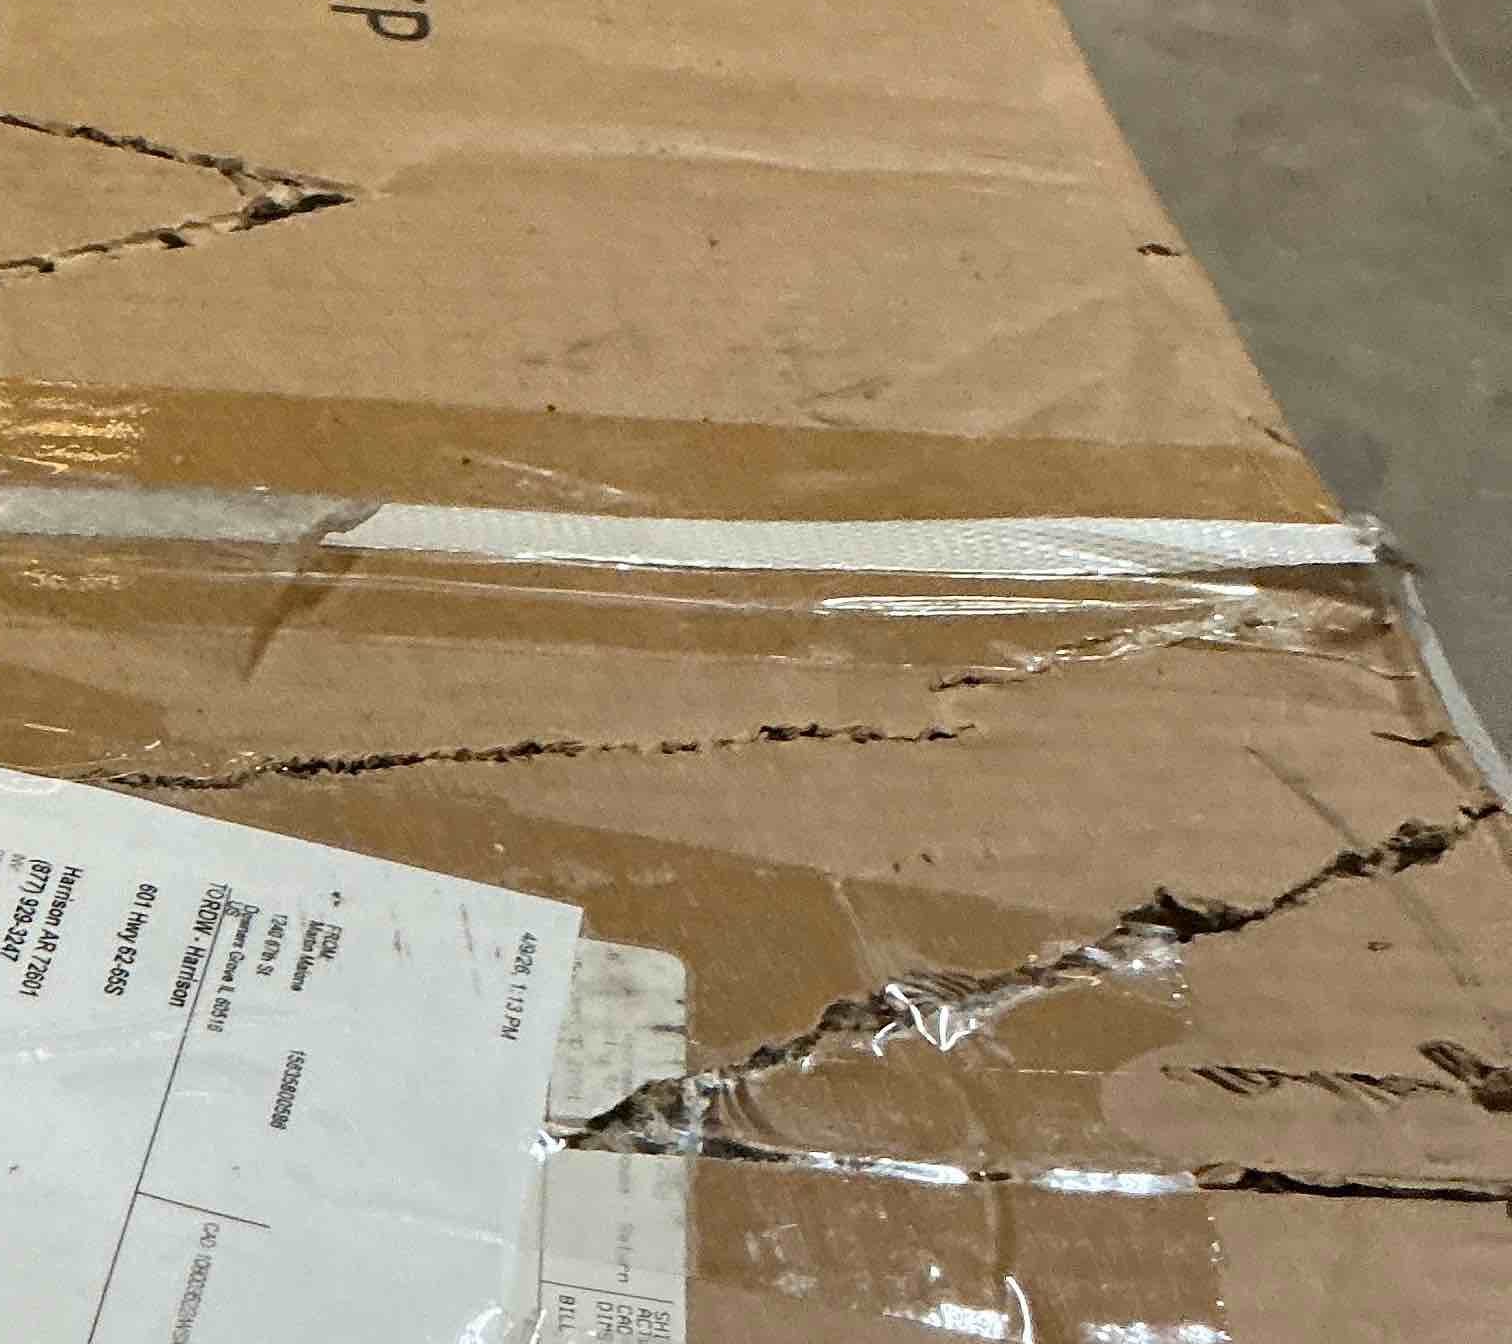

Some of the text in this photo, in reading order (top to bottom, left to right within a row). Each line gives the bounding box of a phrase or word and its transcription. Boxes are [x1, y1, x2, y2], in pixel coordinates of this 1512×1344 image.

[18, 859, 53, 895] (877)
[18, 865, 84, 998] Harrison AR 72601
[193, 899, 221, 936] RDW
[103, 883, 159, 997] 601 Hwy 62-65S
[168, 945, 206, 1008] Harrison
[221, 950, 246, 983] Grove
[500, 1013, 521, 1041] PM
